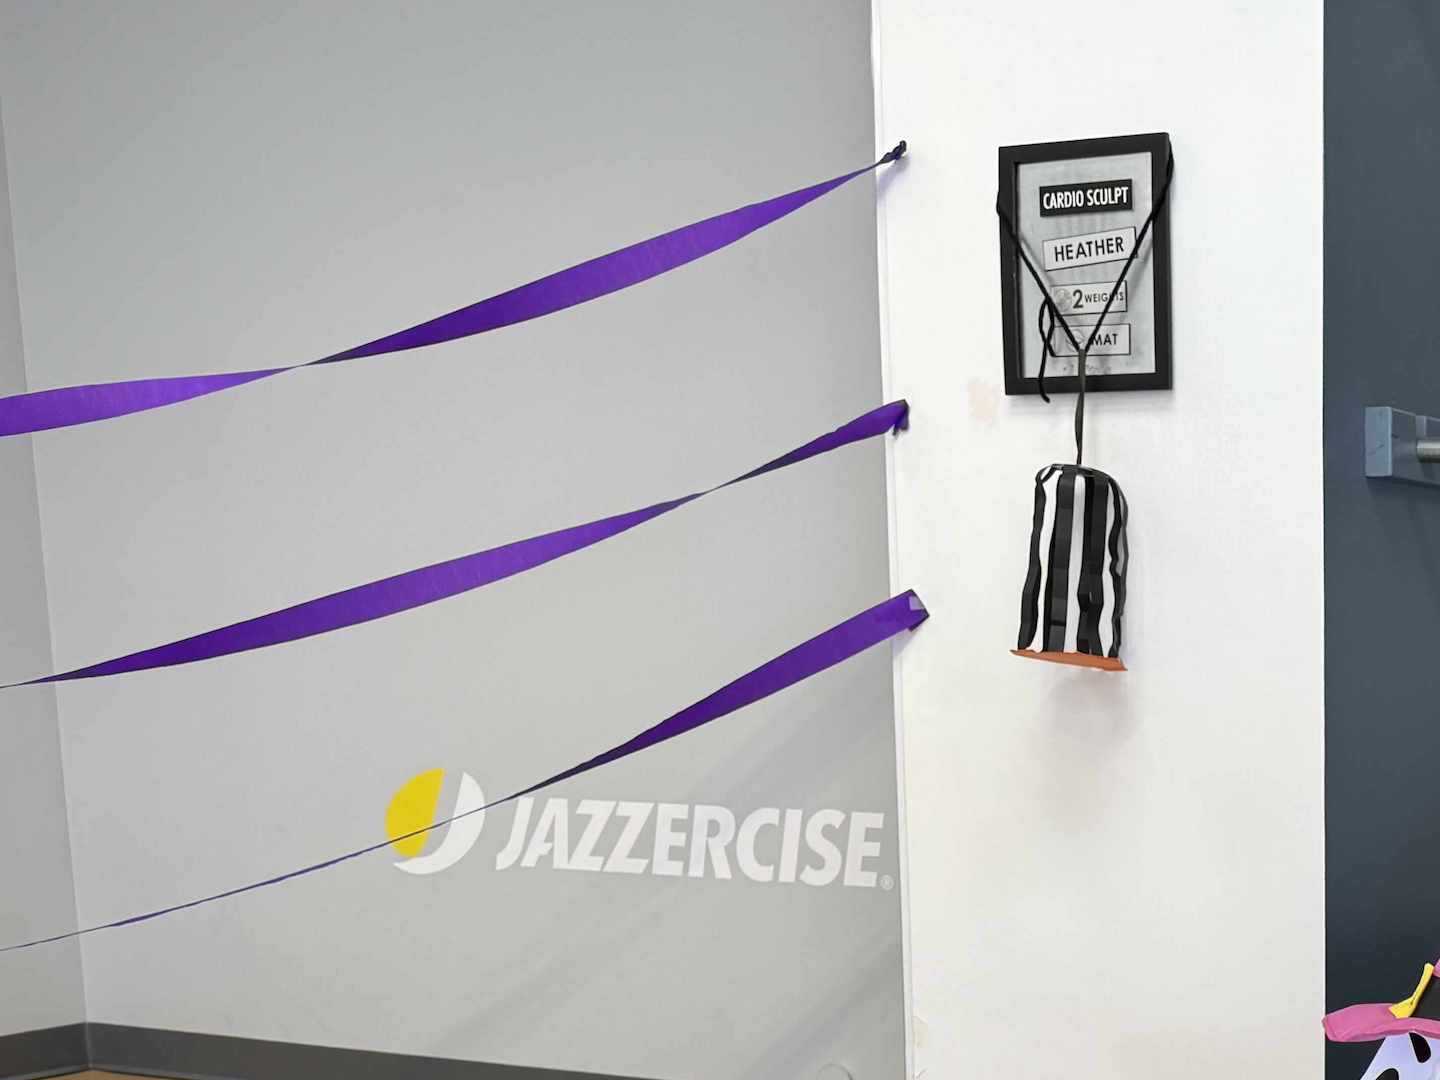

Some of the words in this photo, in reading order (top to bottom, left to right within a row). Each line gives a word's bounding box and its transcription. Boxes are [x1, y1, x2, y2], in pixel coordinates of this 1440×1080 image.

[1043, 190, 1084, 210] CARDIO
[1086, 186, 1129, 207] SCULPT
[1054, 236, 1125, 262] HEATHER
[1072, 289, 1084, 309] 2
[1084, 291, 1124, 304] WEIGS
[1090, 333, 1118, 346] MAT
